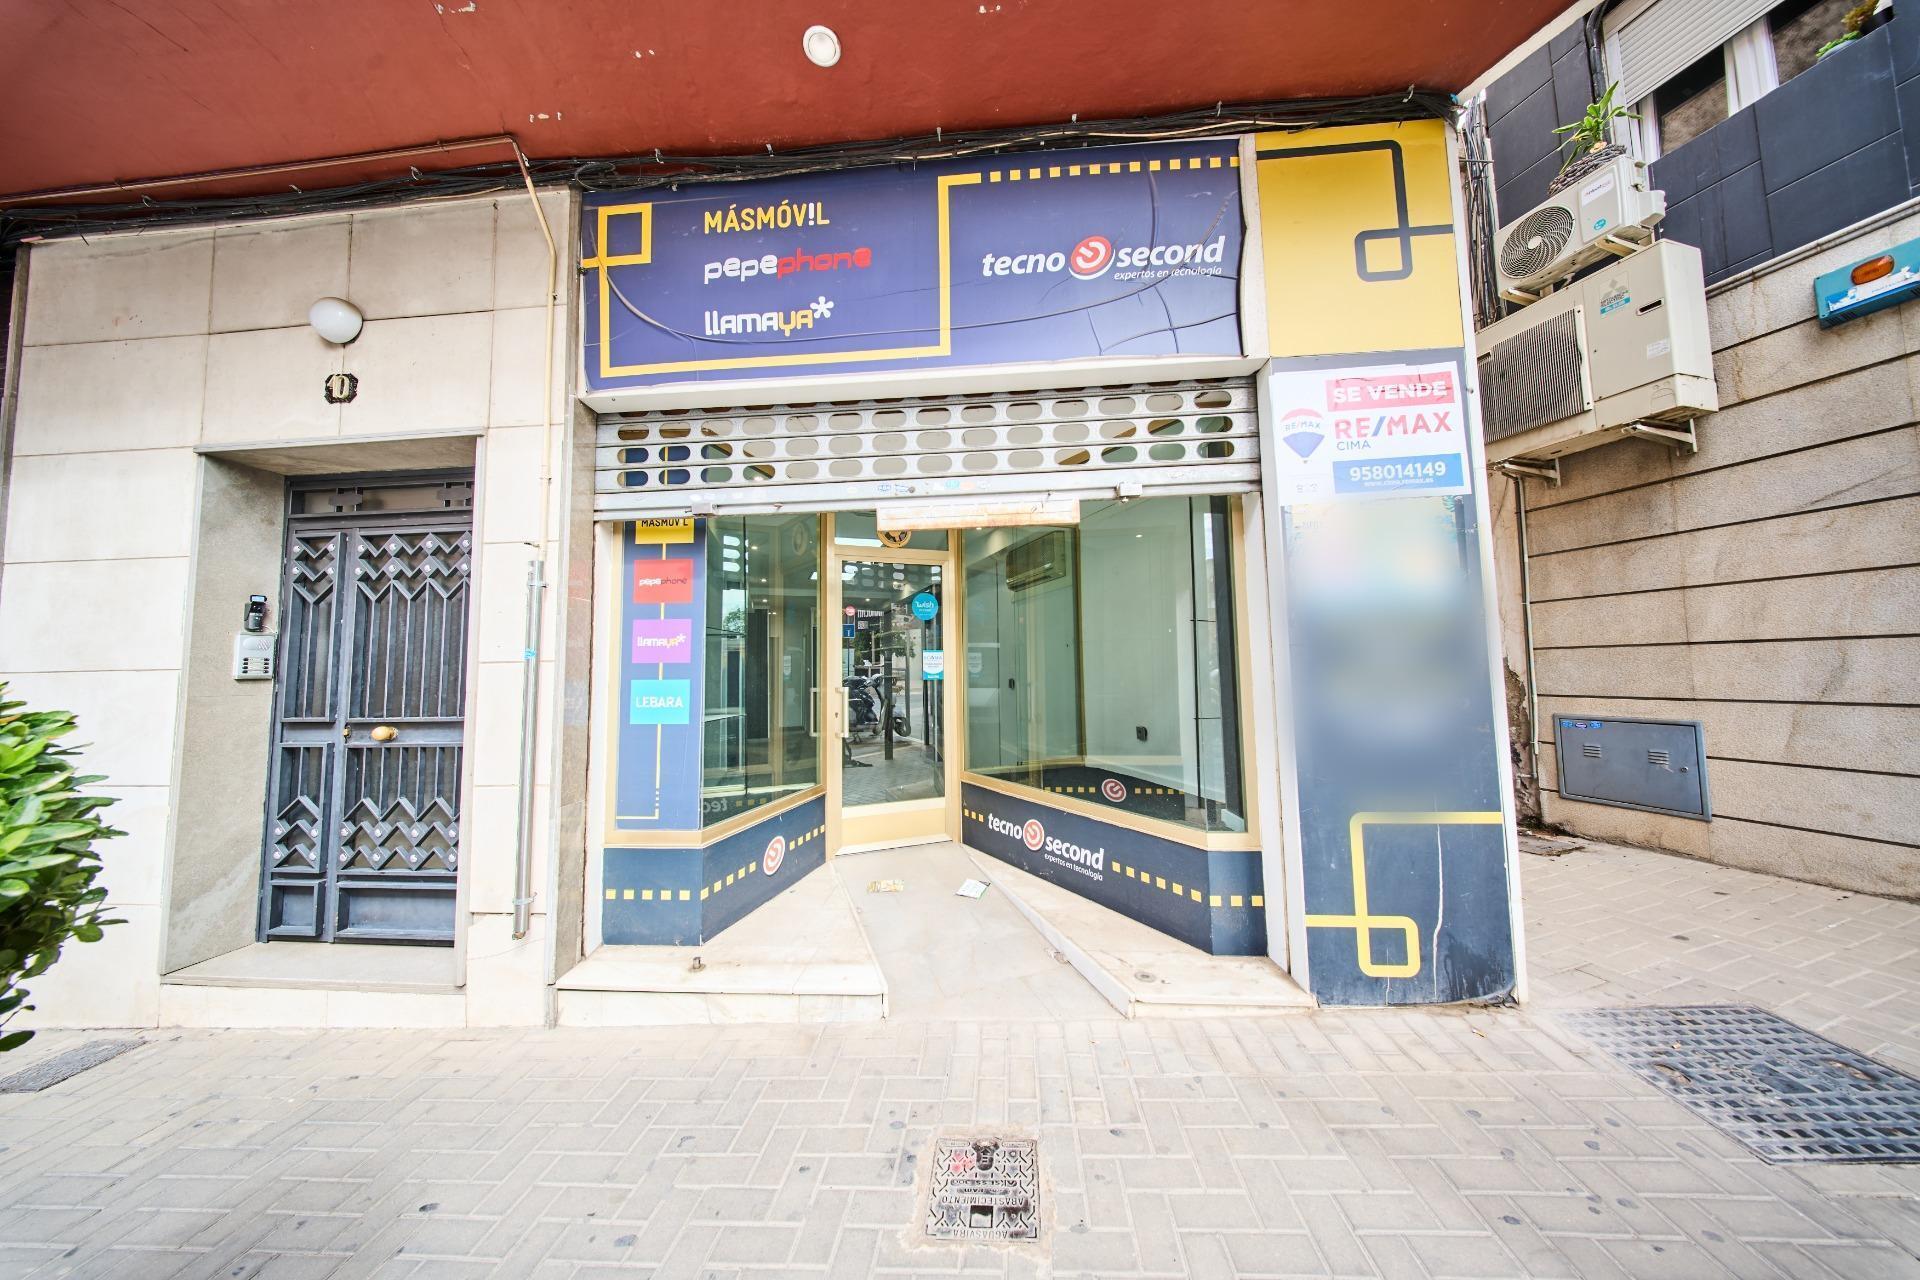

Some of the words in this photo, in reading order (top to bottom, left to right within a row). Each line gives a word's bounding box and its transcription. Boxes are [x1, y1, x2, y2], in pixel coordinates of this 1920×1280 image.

[704, 248, 872, 285] pepephone
[982, 251, 1065, 277] tecno
[1116, 235, 1226, 268] second
[1114, 269, 1155, 281] expertos
[326, 375, 350, 399] 10
[1334, 388, 1361, 404] SE
[1368, 380, 1448, 401] VENDE
[1334, 411, 1453, 440] RE/MAX
[1336, 440, 1372, 451] CIMA
[1349, 461, 1447, 481] 958014149
[636, 696, 684, 708] LEBARA
[988, 813, 1022, 840] tecno
[1045, 836, 1105, 871] second
[1044, 853, 1066, 867] expertos
[1065, 861, 1073, 869] en
